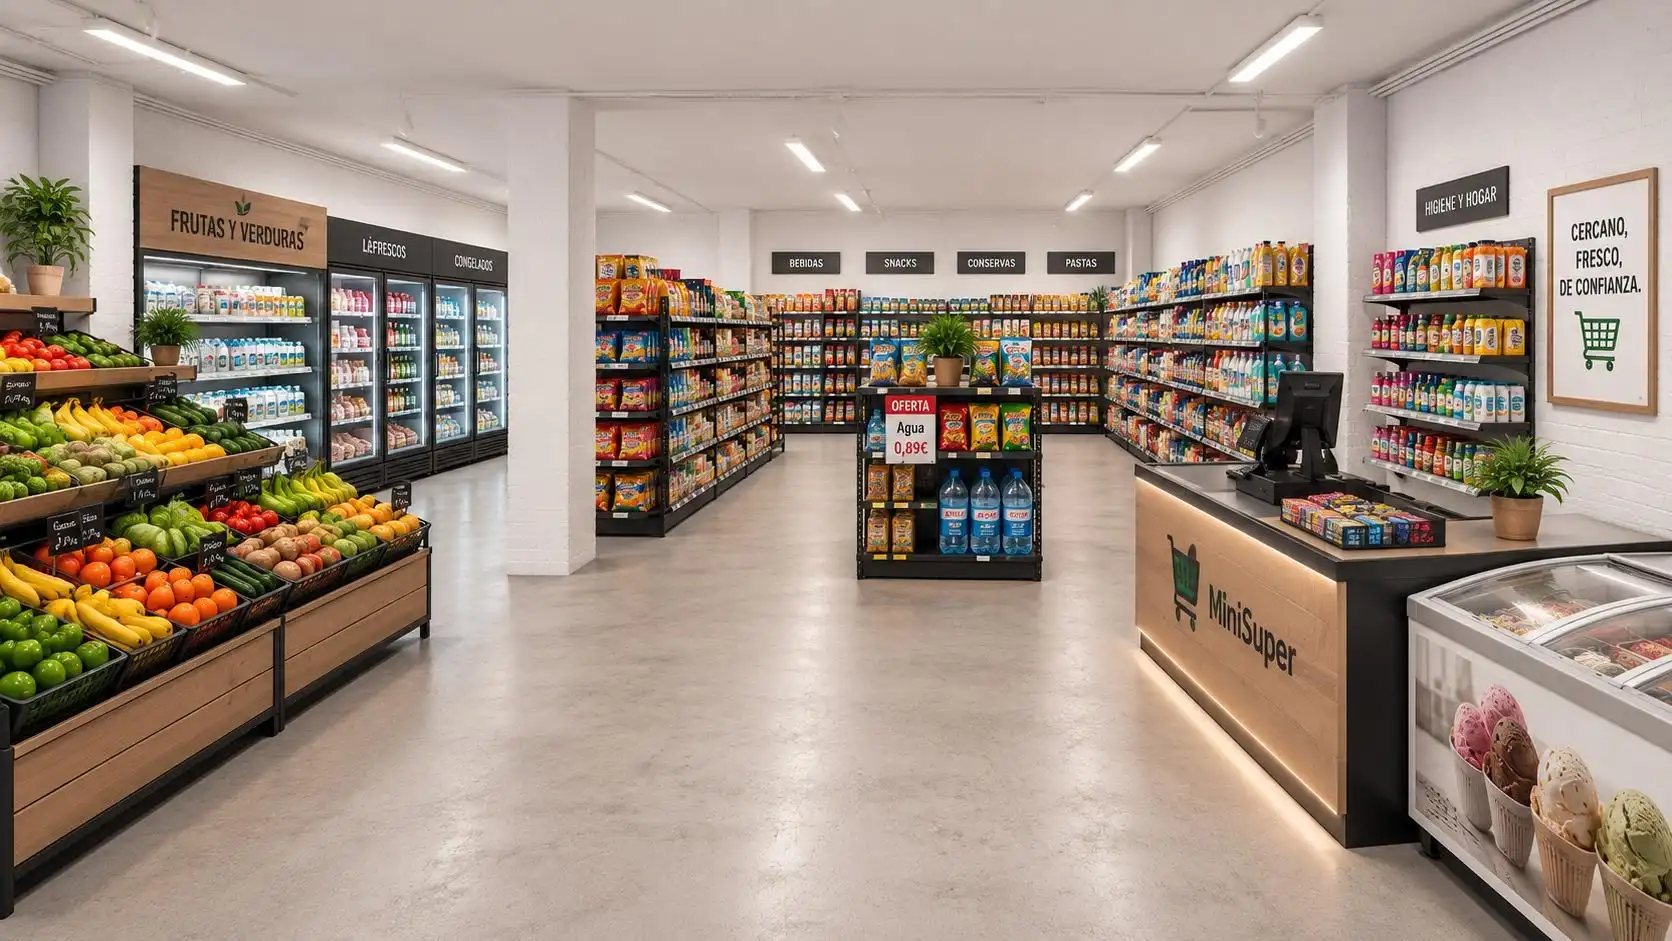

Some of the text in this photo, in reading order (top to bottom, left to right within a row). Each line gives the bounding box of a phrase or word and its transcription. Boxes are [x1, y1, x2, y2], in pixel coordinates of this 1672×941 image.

[1424, 185, 1497, 216] HIGIENE Y HOGAR
[171, 210, 304, 251] FRUTAS Y VERDURAS
[1571, 216, 1628, 241] CERCANO,
[454, 254, 494, 272] CONGELADOS
[789, 258, 824, 268] BEBIDAS
[884, 258, 917, 268] SNACKS
[967, 258, 1016, 268] CONSERVAS
[1065, 258, 1097, 268] PASTAS
[1576, 246, 1623, 270] FRESCO,
[1559, 275, 1642, 296] DE CONFIANZA.
[891, 399, 930, 412] OFERTA
[896, 421, 925, 435] Agua
[894, 441, 928, 457] 0,89€
[1209, 583, 1297, 676] MiniSuper
